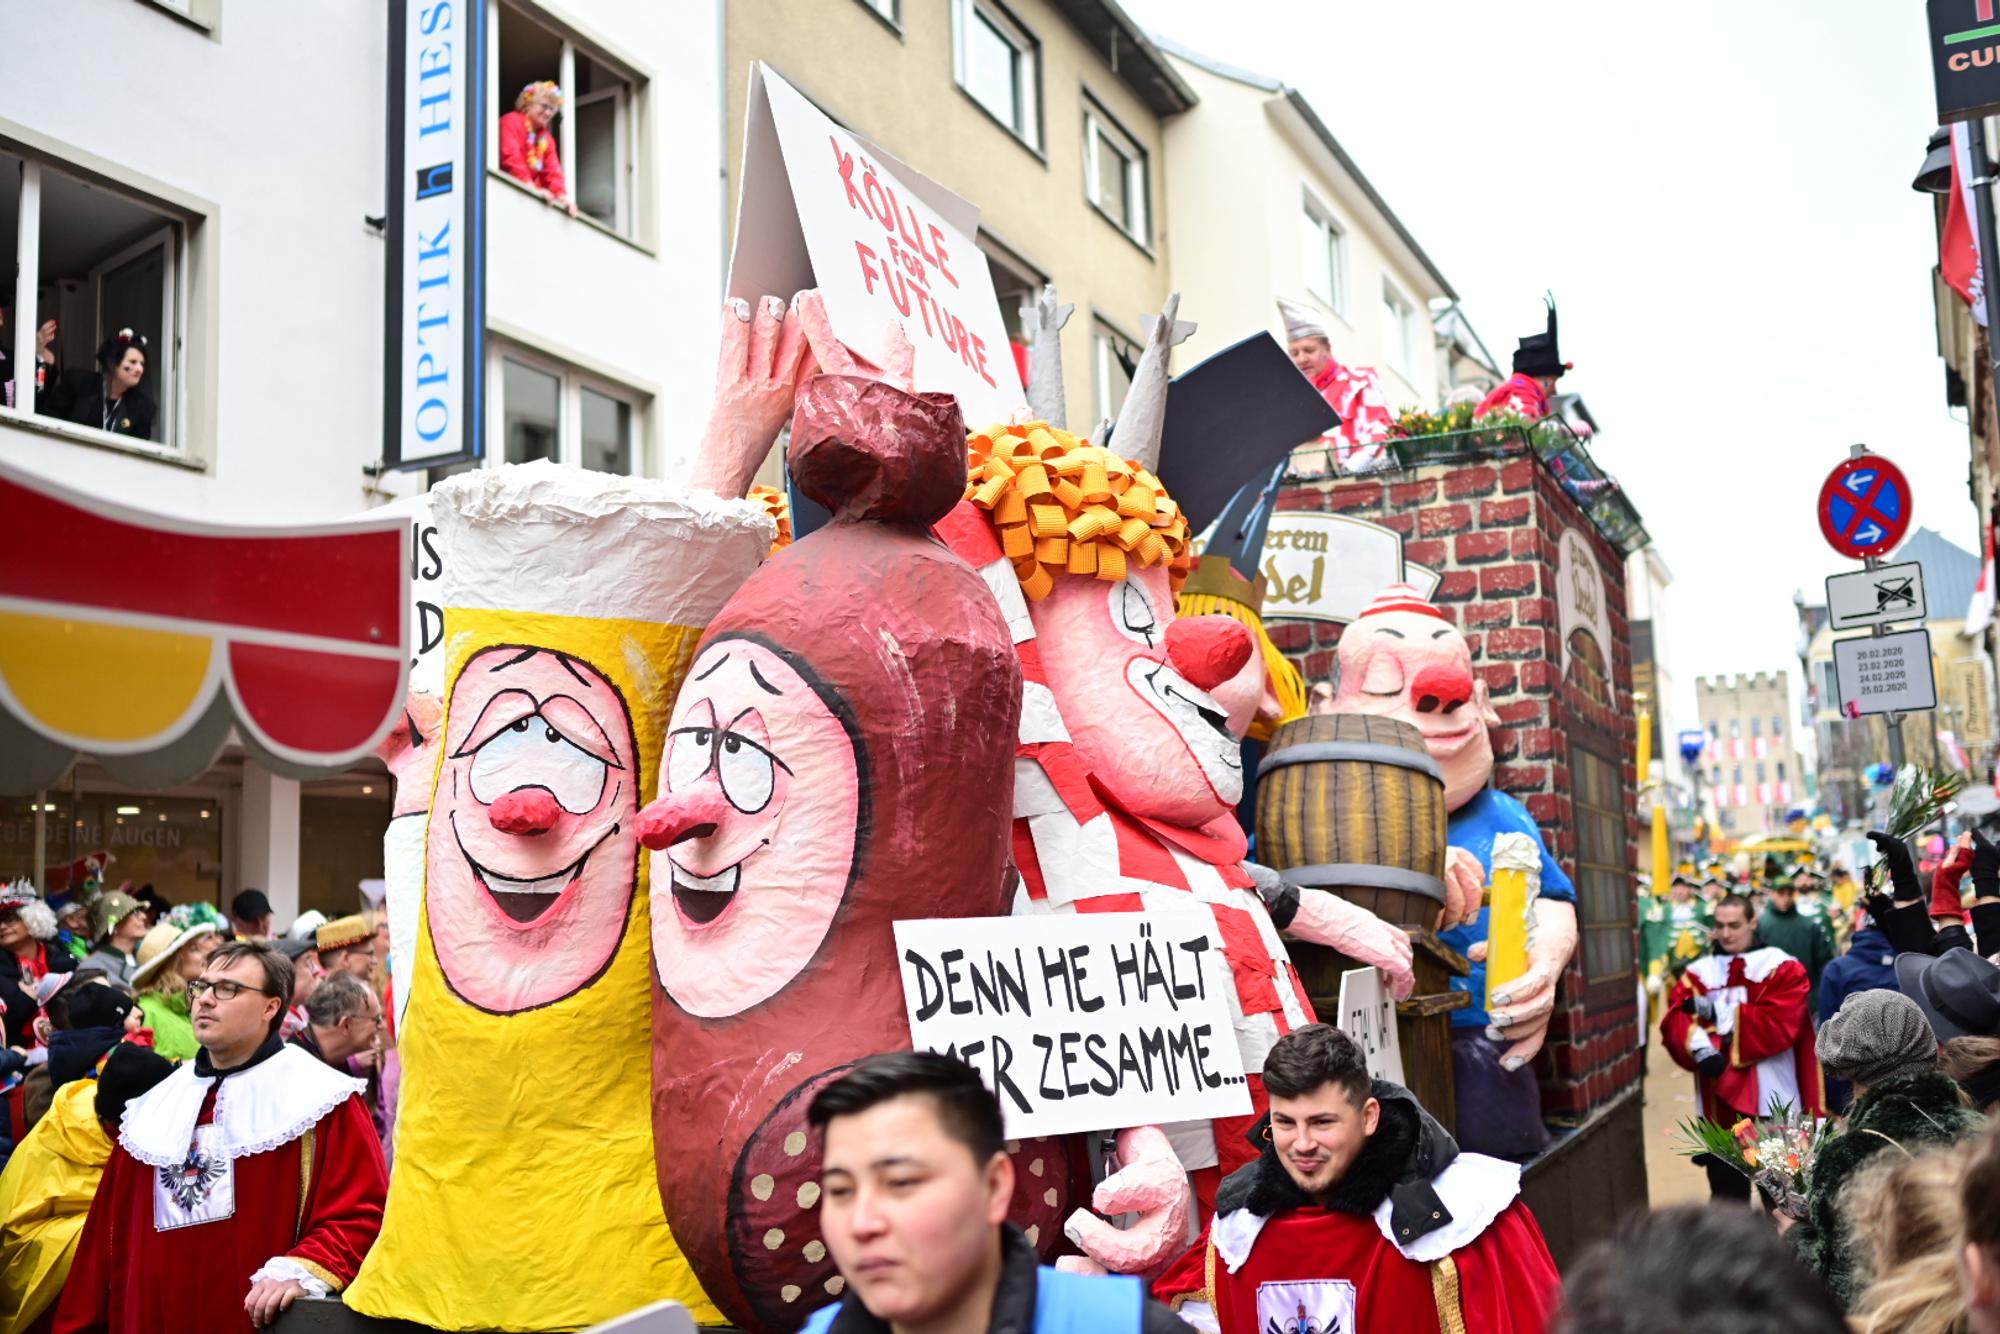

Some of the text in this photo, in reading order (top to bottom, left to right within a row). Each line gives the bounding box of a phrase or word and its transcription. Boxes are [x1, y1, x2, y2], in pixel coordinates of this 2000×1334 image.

[416, 1, 453, 443] OPTIK h HES
[830, 135, 960, 289] KÖLLE
[886, 236, 931, 290] FOR
[855, 240, 997, 389] FUTURE
[1265, 529, 1329, 553] erem
[1264, 554, 1326, 605] del
[1857, 647, 1903, 660] 20.02.2020
[1858, 659, 1905, 671] 23.02.2020
[1860, 671, 1906, 683] 24.02.2020
[1861, 682, 1907, 695] 25.02.2020
[0, 821, 30, 843] BE
[110, 825, 181, 848] AUGEN
[905, 922, 1209, 1022] DENN HE HÄLT
[1032, 1023, 1246, 1101] ZESAMME...
